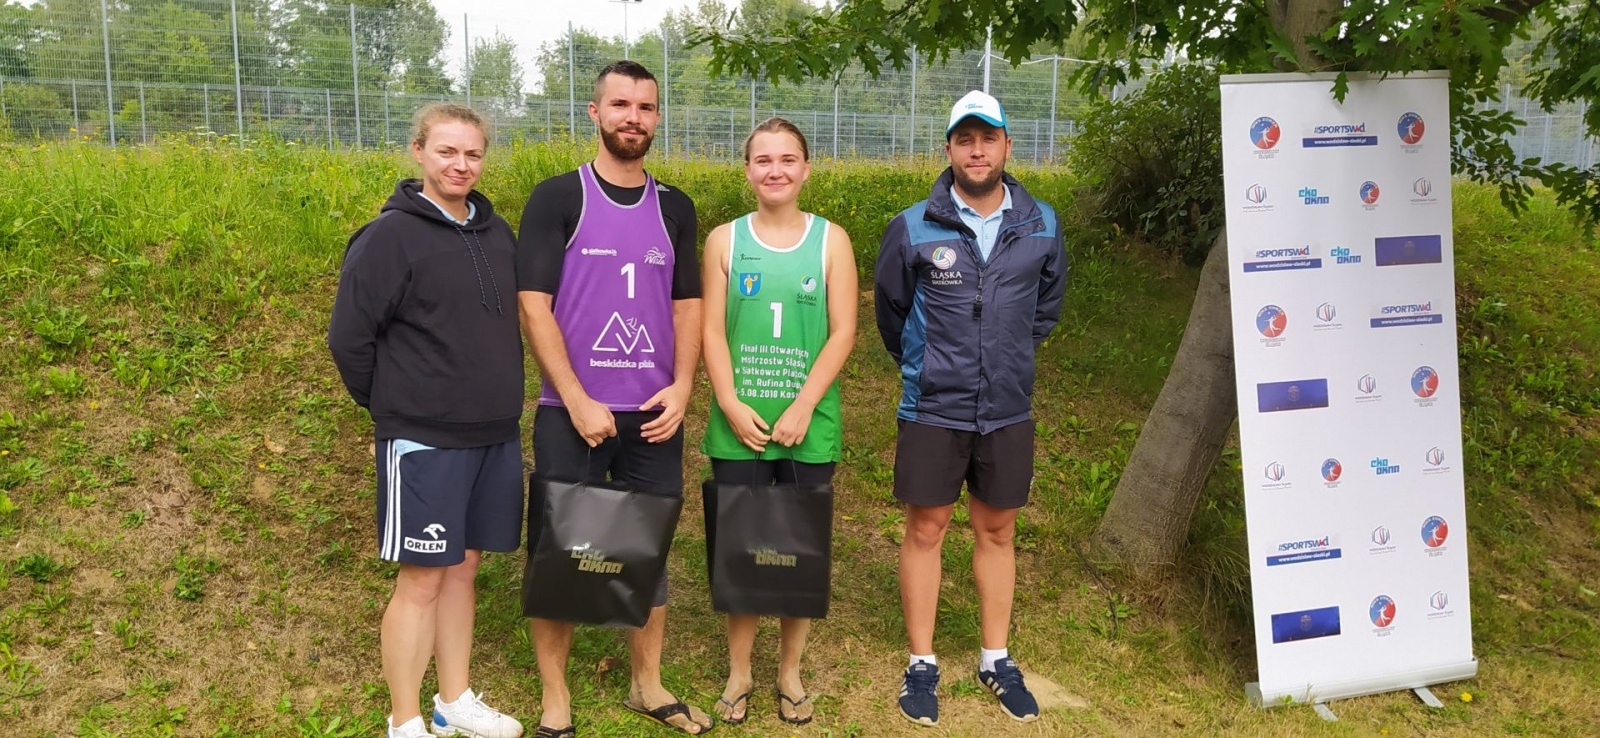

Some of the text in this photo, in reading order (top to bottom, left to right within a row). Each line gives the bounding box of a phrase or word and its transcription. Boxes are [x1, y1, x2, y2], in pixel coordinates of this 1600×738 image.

[621, 262, 635, 299] 1
[770, 302, 783, 338] 1
[760, 345, 768, 353] III
[770, 345, 809, 359] Otwartych
[590, 358, 637, 368] beskidzka
[742, 377, 754, 386] im.
[757, 378, 784, 388] Rufina
[407, 540, 444, 551] ORLEN
